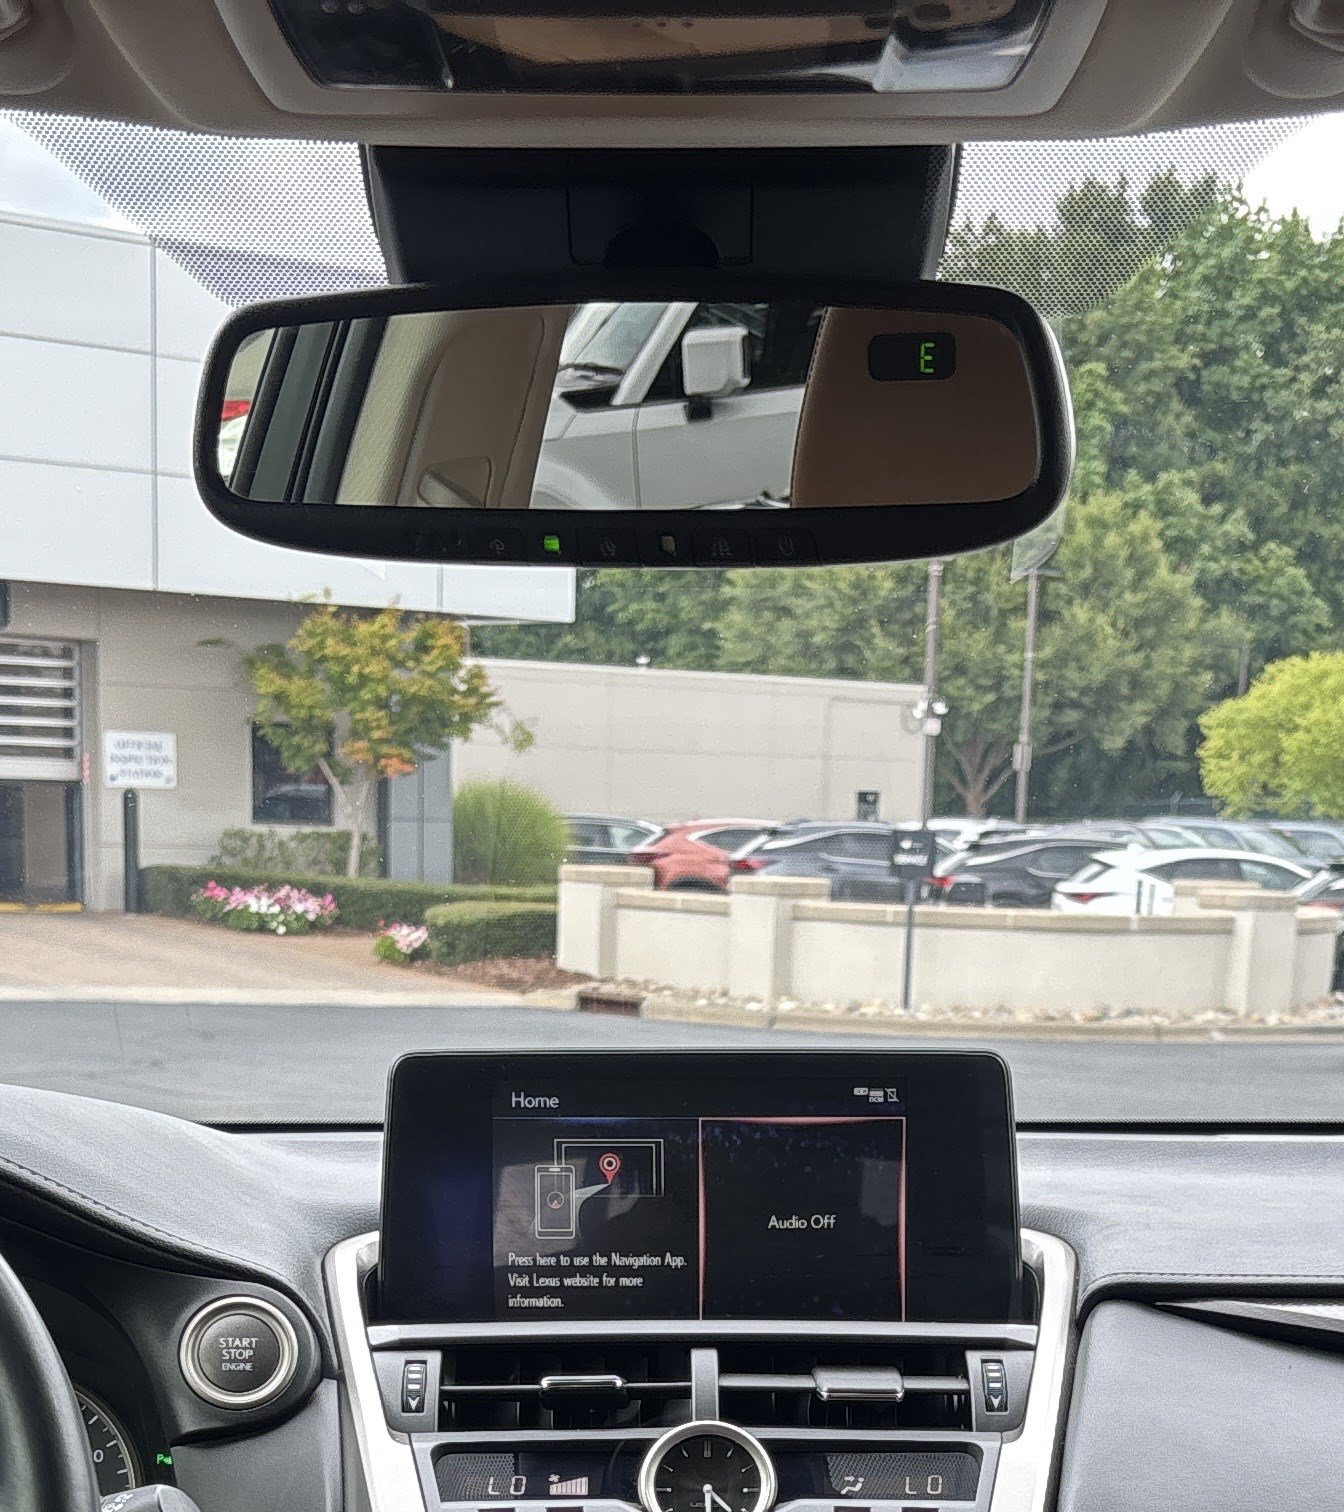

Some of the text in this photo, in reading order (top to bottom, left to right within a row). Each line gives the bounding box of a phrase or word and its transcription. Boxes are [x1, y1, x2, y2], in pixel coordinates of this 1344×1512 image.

[920, 342, 935, 373] E
[511, 1092, 560, 1109] Home
[768, 1214, 837, 1230] Audio Off
[508, 1252, 687, 1269] Press here to use the Navigation App.
[508, 1273, 643, 1287] Visit Lexus website for more
[508, 1294, 564, 1308] information.
[218, 1337, 259, 1348] START
[221, 1349, 253, 1360] STOP
[221, 1362, 254, 1371] ENGINE
